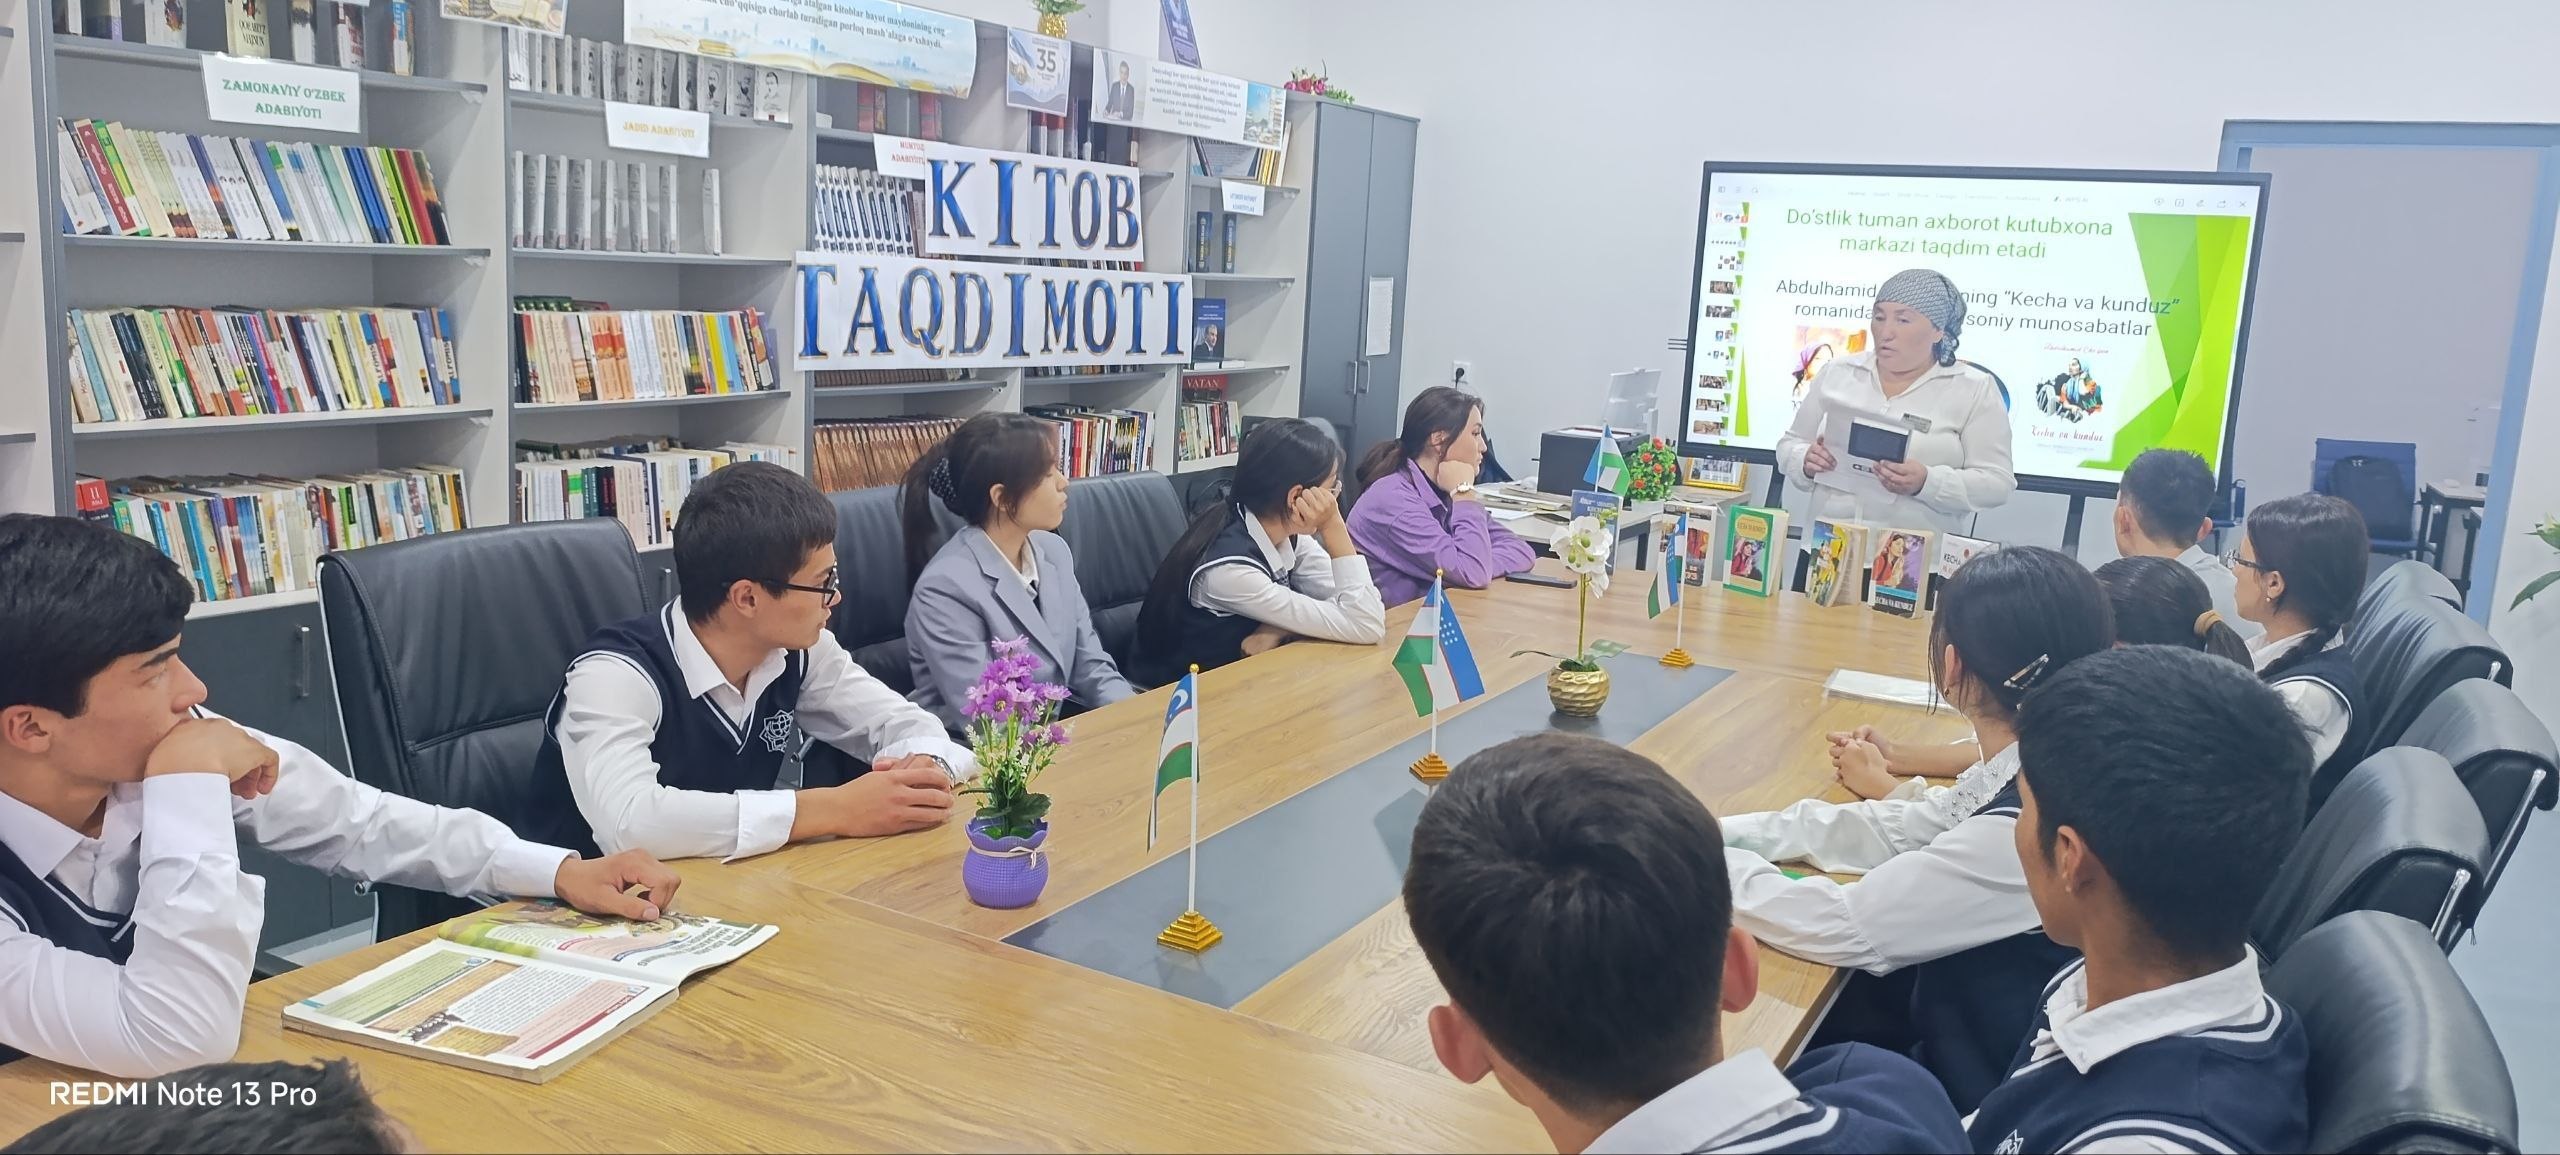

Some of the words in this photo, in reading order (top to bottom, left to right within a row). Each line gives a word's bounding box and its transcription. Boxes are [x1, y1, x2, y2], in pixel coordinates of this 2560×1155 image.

[769, 6, 799, 20] chorlab
[834, 4, 863, 17] kitoblar
[1036, 47, 1056, 73] 35
[222, 79, 301, 98] ZAMONAVIY
[303, 87, 346, 102] O'ZBEK
[255, 103, 322, 119] ADABIYOTI
[926, 157, 1141, 251] KITOB
[1787, 208, 1852, 226] Do'stlik
[1858, 212, 1918, 228] tuman
[1924, 213, 2000, 232] axborot
[2006, 215, 2113, 236] kutubxona
[1839, 235, 1915, 253] markazi
[1921, 238, 1989, 258] taqdim
[1996, 241, 2047, 259] etadi
[1776, 279, 1877, 298] Abdulhamid
[2074, 298, 2094, 310] va
[798, 263, 1185, 359] TAQDIMOTI
[1966, 313, 2014, 331] soniy
[2020, 317, 2152, 337] munosabatlar
[1187, 378, 1219, 388] VATAN
